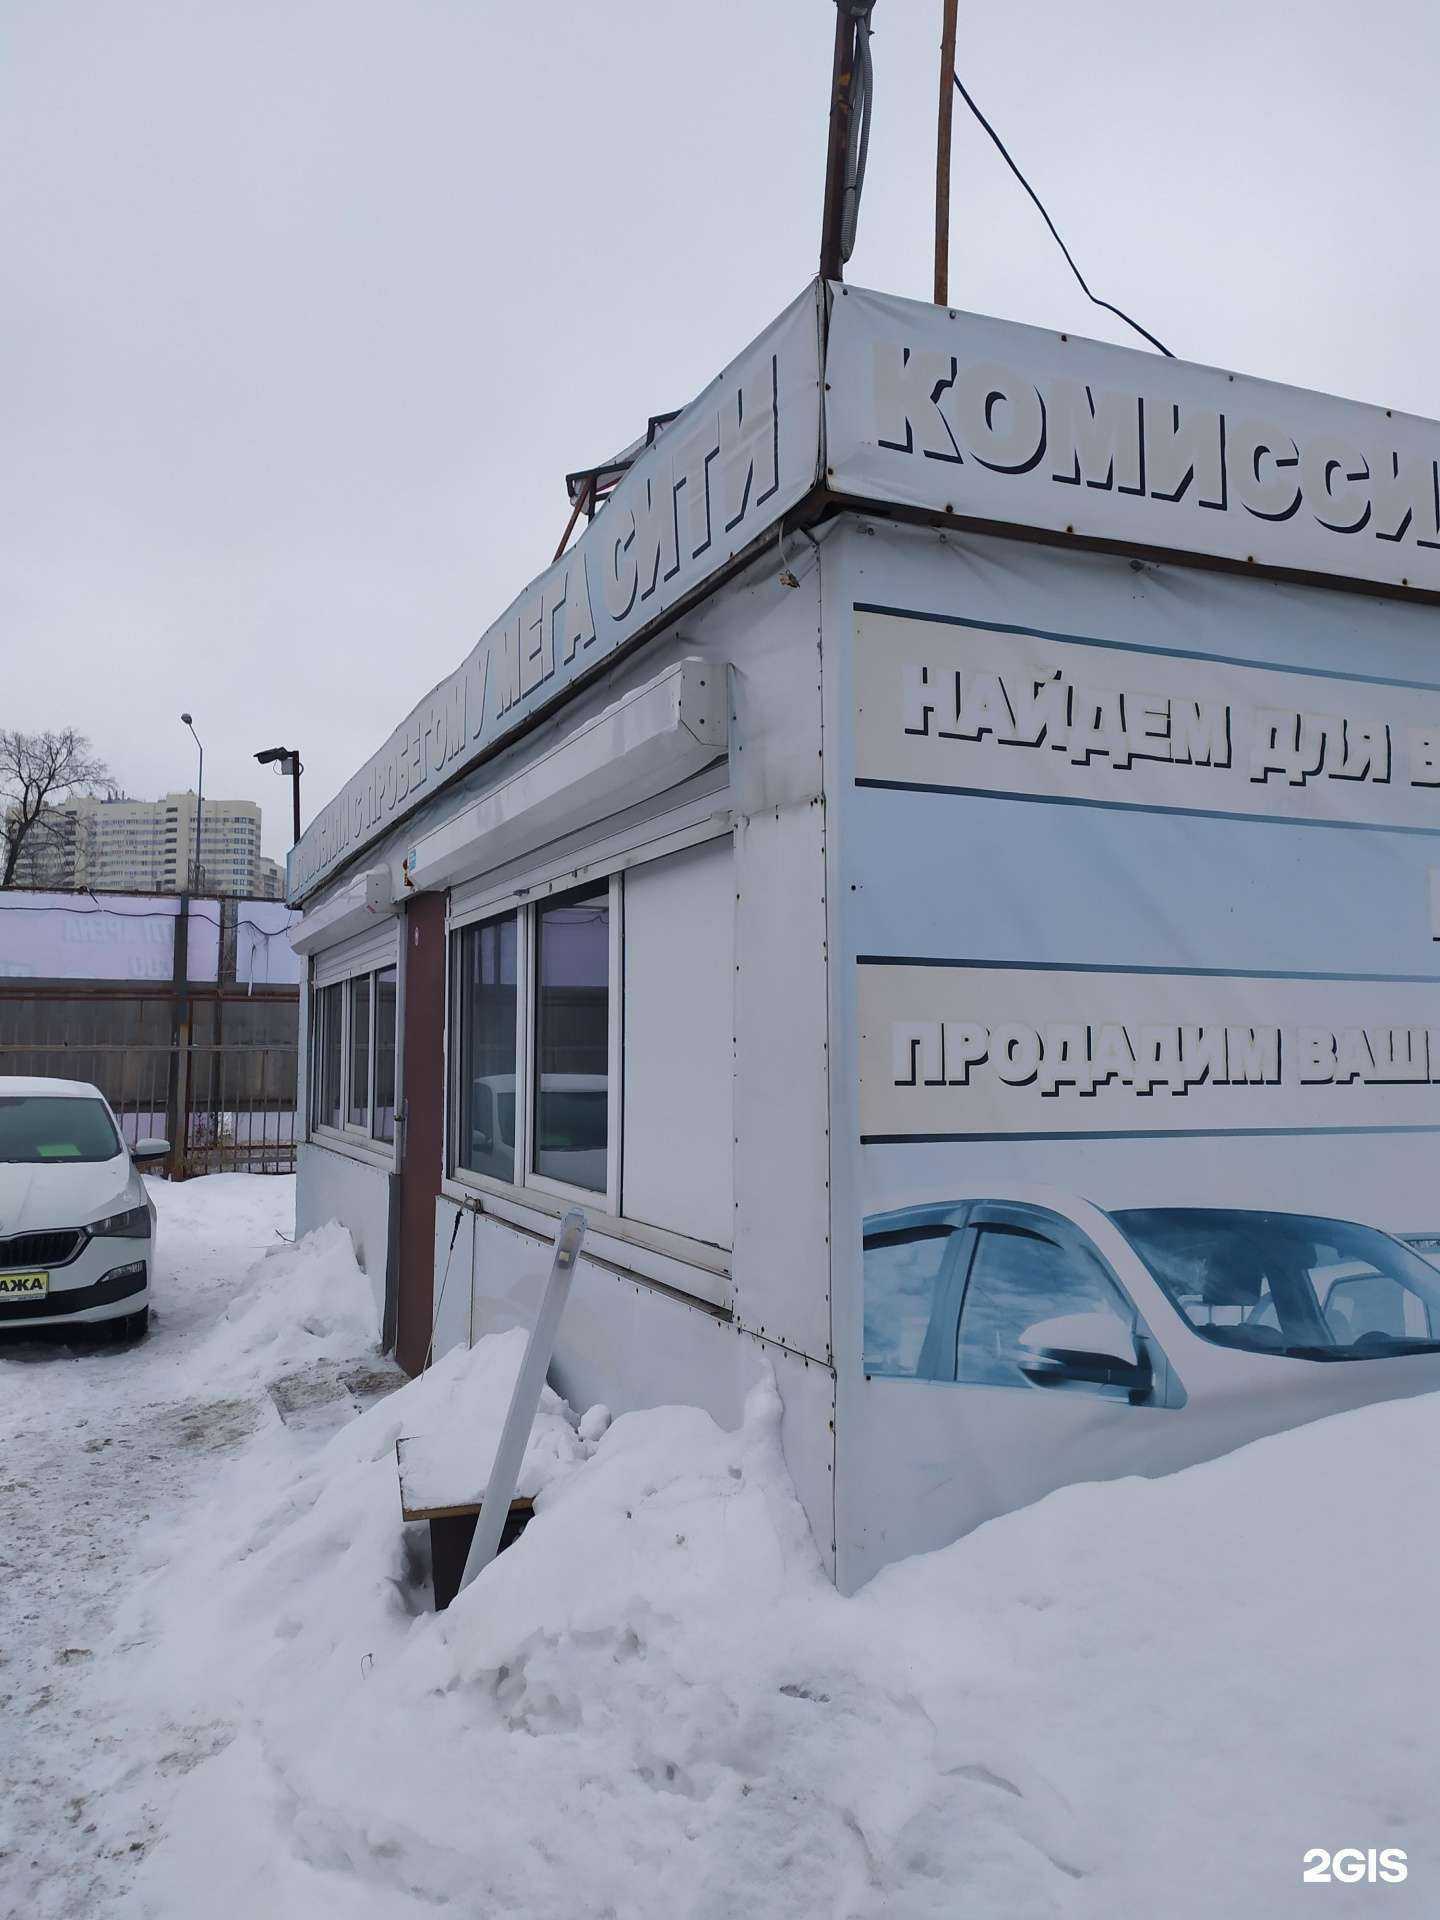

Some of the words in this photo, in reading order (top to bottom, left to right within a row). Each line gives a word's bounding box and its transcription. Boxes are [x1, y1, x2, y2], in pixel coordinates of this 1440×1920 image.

[872, 343, 1440, 549] КОМИССИ
[364, 667, 467, 829] ПРОБЕГОМ
[495, 546, 597, 721] МЕГА
[605, 350, 779, 622] СИТИ
[900, 662, 1233, 770] НАЙДЕМ
[1252, 704, 1392, 786] ДЛЯ
[890, 1019, 1282, 1096] ПРОДАДИМ
[1297, 1024, 1440, 1085] ВАШ
